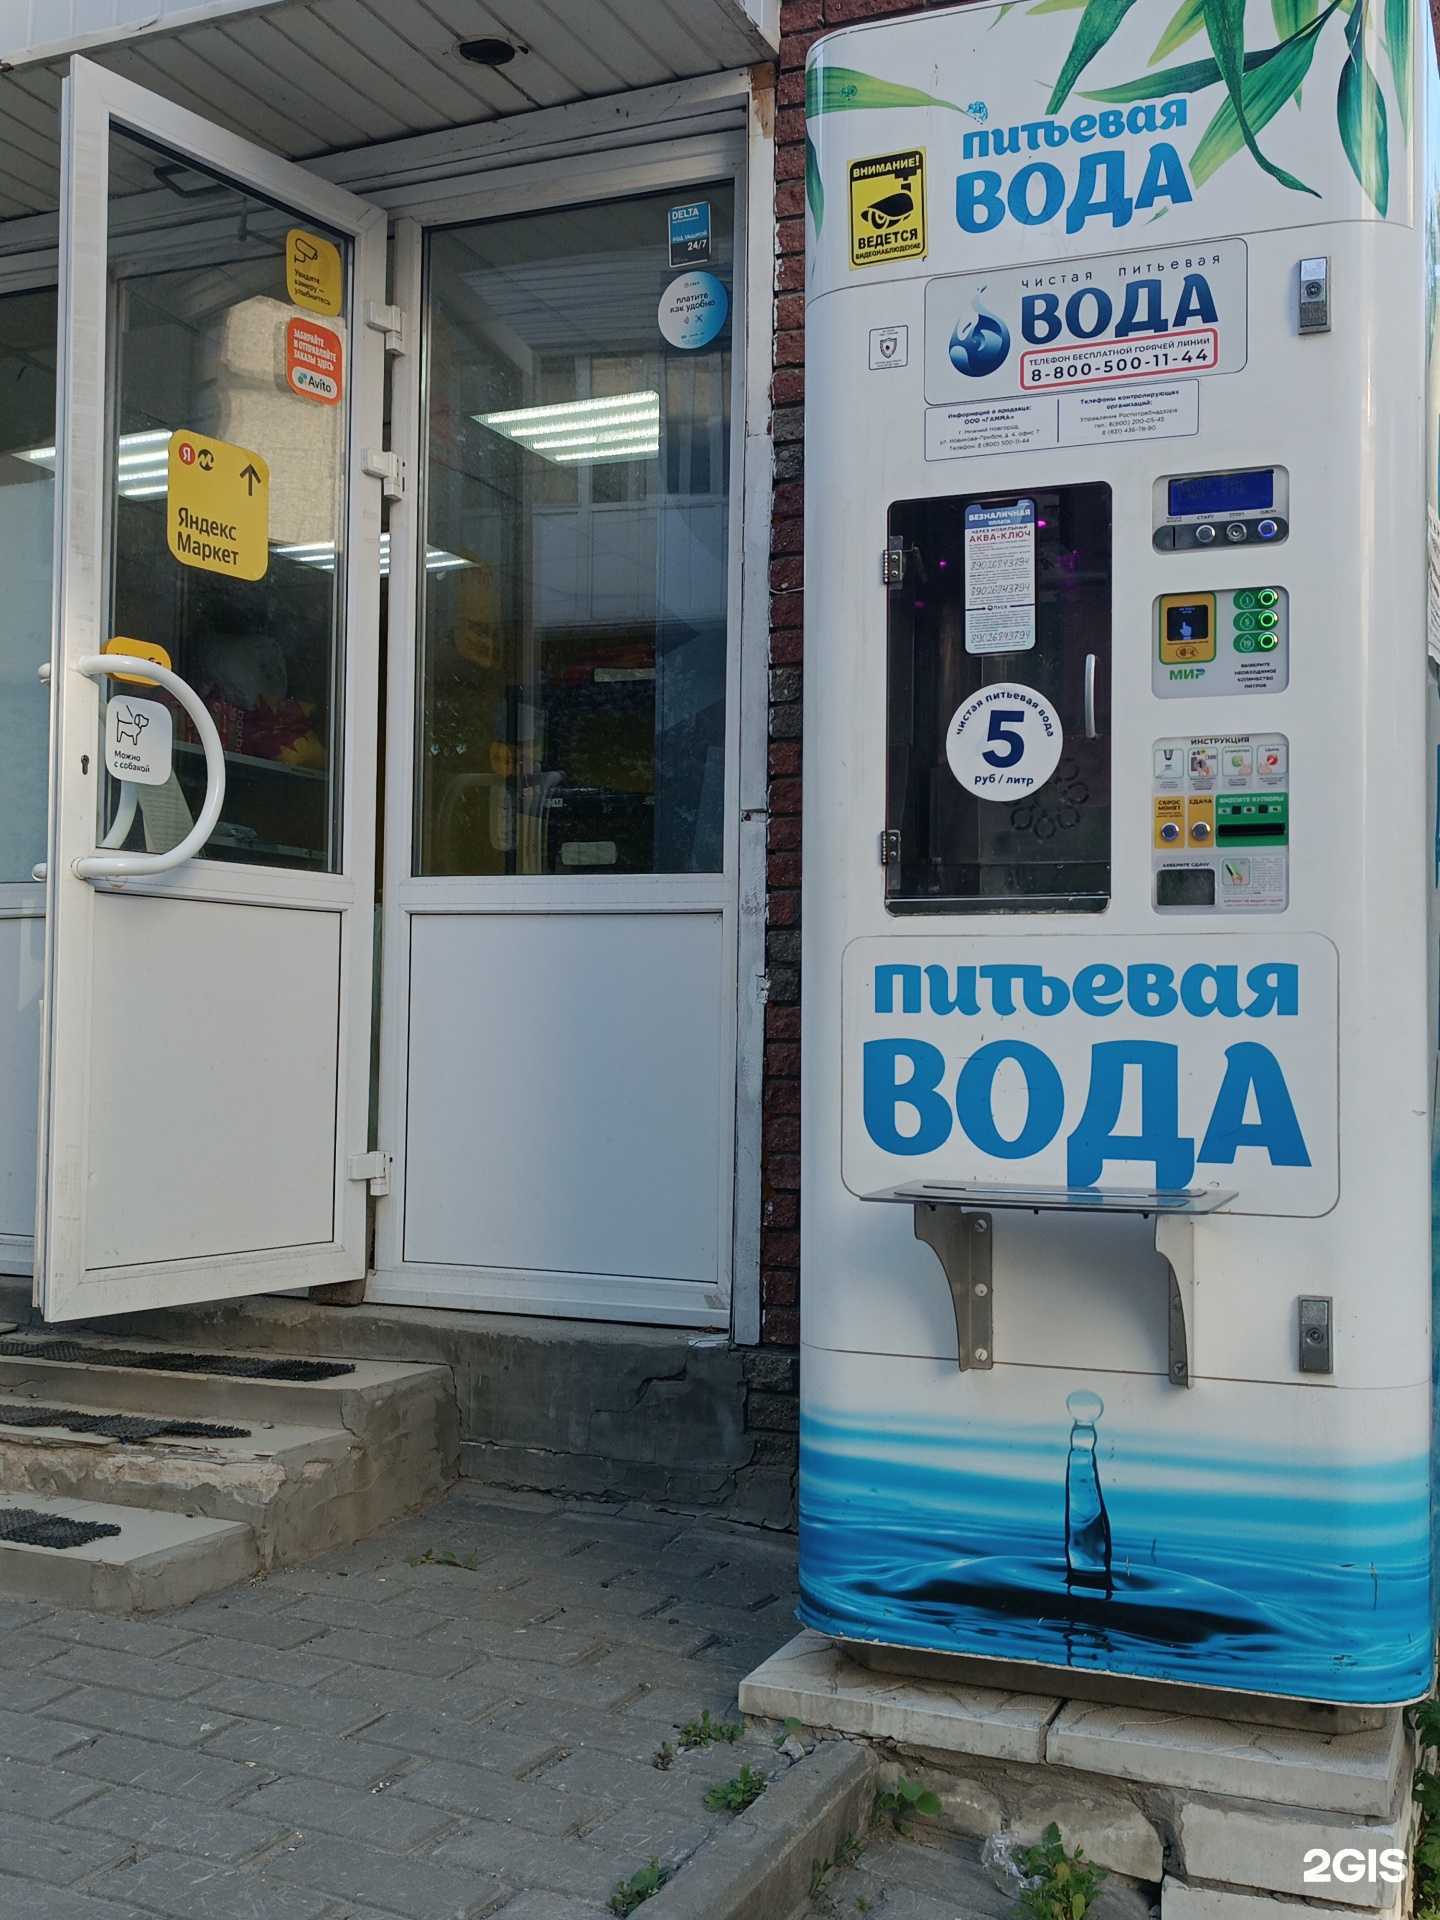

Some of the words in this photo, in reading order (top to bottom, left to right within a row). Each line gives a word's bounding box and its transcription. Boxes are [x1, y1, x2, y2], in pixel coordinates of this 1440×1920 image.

[963, 99, 1187, 160] питьевая
[853, 154, 919, 177] ВНИМАНИЕ!
[956, 143, 1192, 234] ВОДА
[672, 208, 699, 220] DELTA
[687, 239, 707, 251] 24/7
[858, 228, 918, 249] ВЕДЕТСЯ
[855, 243, 921, 259] ВИДЕОНАБЛЮДЕНИЕ
[1021, 271, 1093, 288] чистая
[1118, 255, 1220, 277] питьевая
[670, 306, 684, 314] как
[686, 299, 716, 313] удобно
[676, 292, 709, 305] платите
[1022, 273, 1219, 344] ВОДА
[1029, 355, 1071, 366] ТЕЛЕФОН
[1072, 347, 1133, 361] БЕСПЛАТНОЙ
[1134, 341, 1175, 353] ГОРЯЧЕЙ
[1177, 337, 1210, 348] ЛИНИИ
[1031, 349, 1208, 382] 8-800-500-11-44
[308, 376, 332, 393] Avito
[178, 507, 237, 541] Яндекс
[177, 531, 239, 565] Маркет
[969, 531, 1031, 544] АКВА-КЛЮЧ
[1169, 668, 1206, 681] МИР
[956, 700, 984, 735] чистая
[985, 691, 1039, 709] питьевая
[1038, 709, 1054, 737] вода
[982, 710, 1025, 768] 5
[1190, 737, 1250, 745] ИНСТРУКЦИЯ
[114, 750, 141, 762] Можно
[120, 762, 150, 773] собакой
[974, 774, 996, 786] руб
[1006, 775, 1034, 787] литр
[874, 962, 1299, 1018] питьевая
[863, 1037, 1312, 1190] ВОДА
